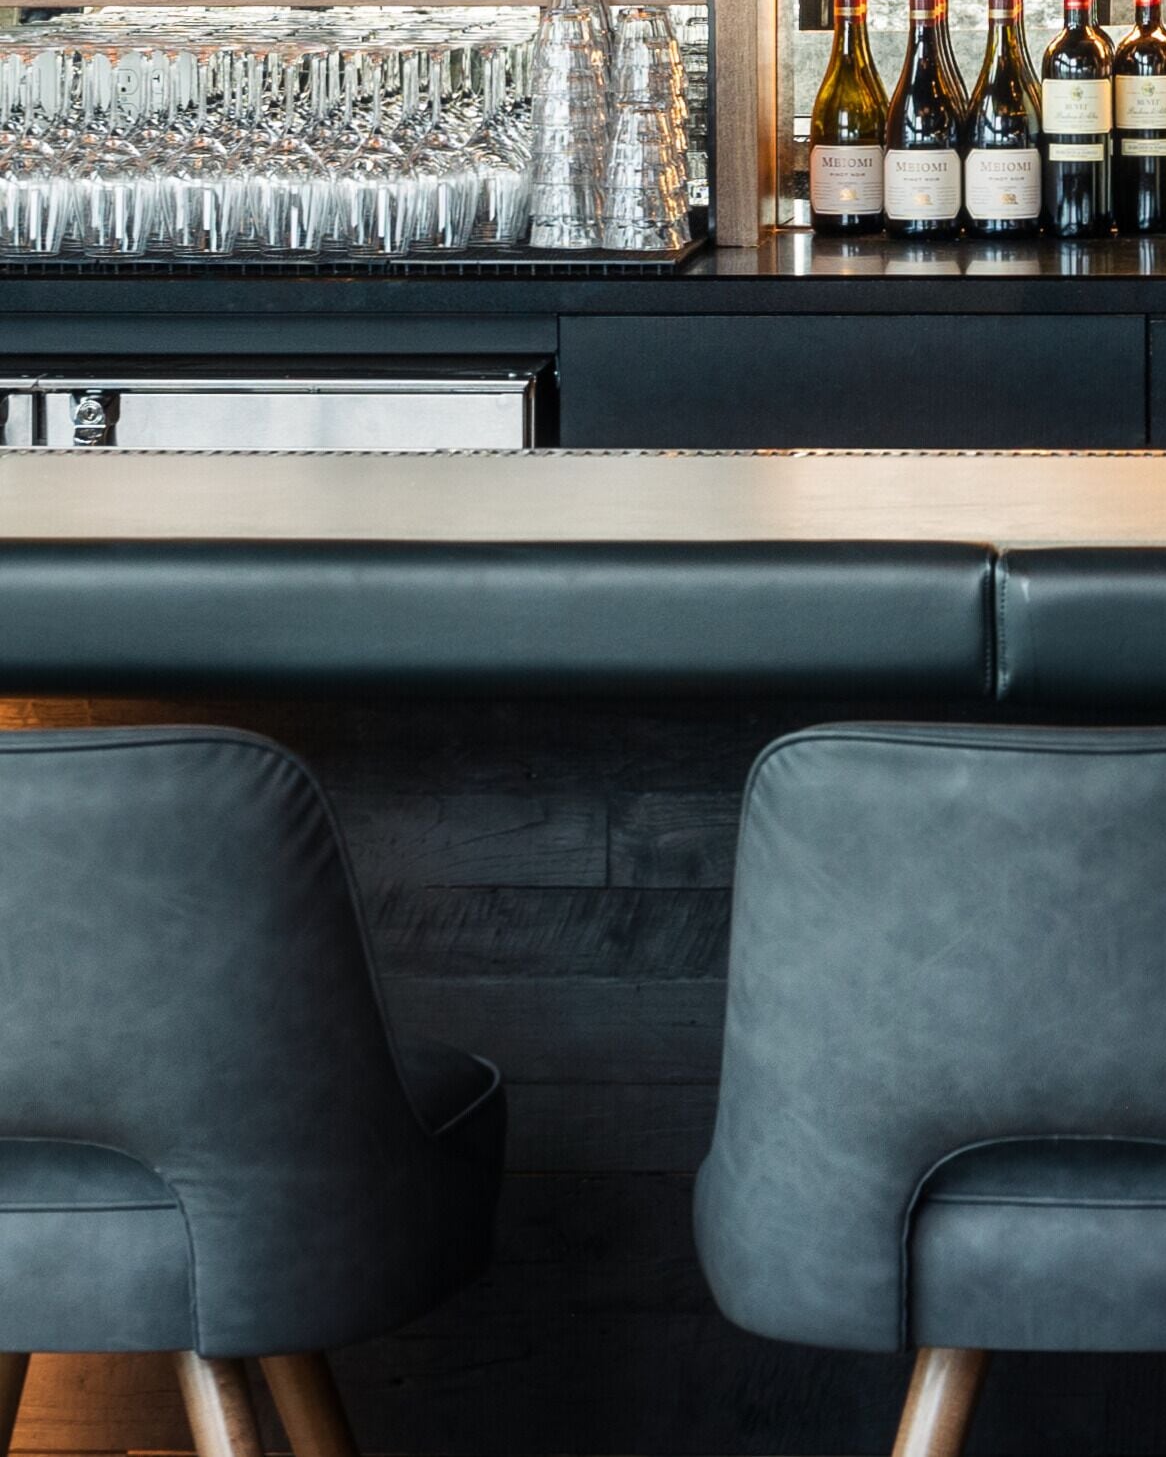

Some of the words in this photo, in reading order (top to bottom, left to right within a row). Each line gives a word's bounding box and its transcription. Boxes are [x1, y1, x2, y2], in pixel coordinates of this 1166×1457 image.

[822, 157, 873, 168] MEIOMI
[896, 162, 948, 172] MEIOMI
[980, 161, 1032, 172] MEIOMI
